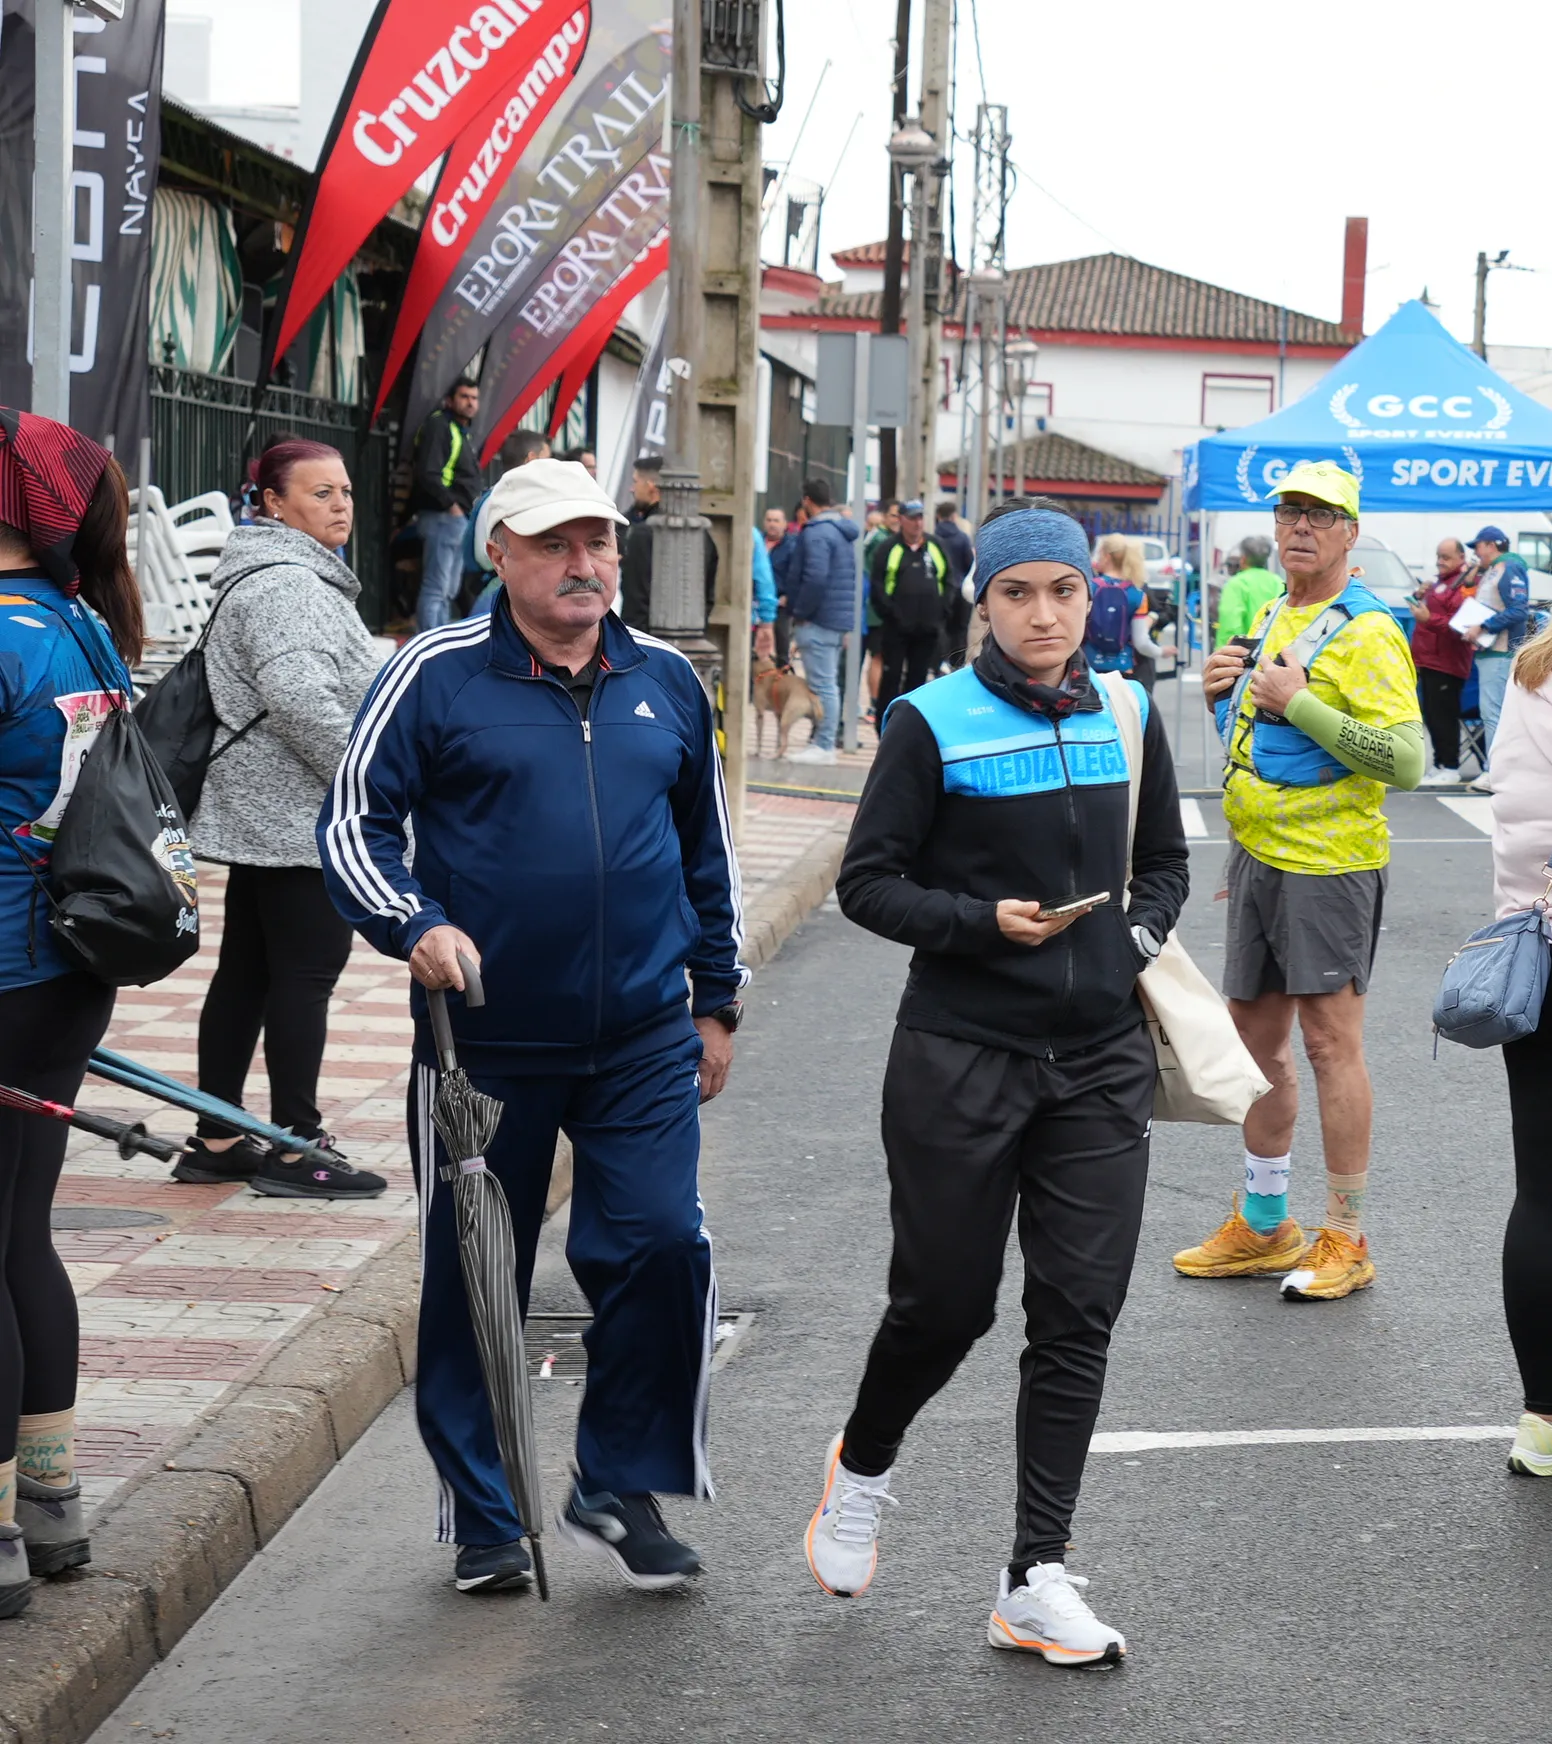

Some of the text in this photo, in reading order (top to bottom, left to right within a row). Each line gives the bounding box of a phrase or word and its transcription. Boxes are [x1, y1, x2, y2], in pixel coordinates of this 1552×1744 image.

[431, 10, 586, 247] Cruzcampo
[454, 197, 562, 311] EPORA
[536, 70, 670, 200] TRAIL
[518, 229, 618, 333] EPORA
[1367, 394, 1473, 418] GCC
[1391, 459, 1500, 487] SPORT
[1339, 726, 1395, 761] SOLIDARIA
[970, 748, 1061, 792] MEDIA
